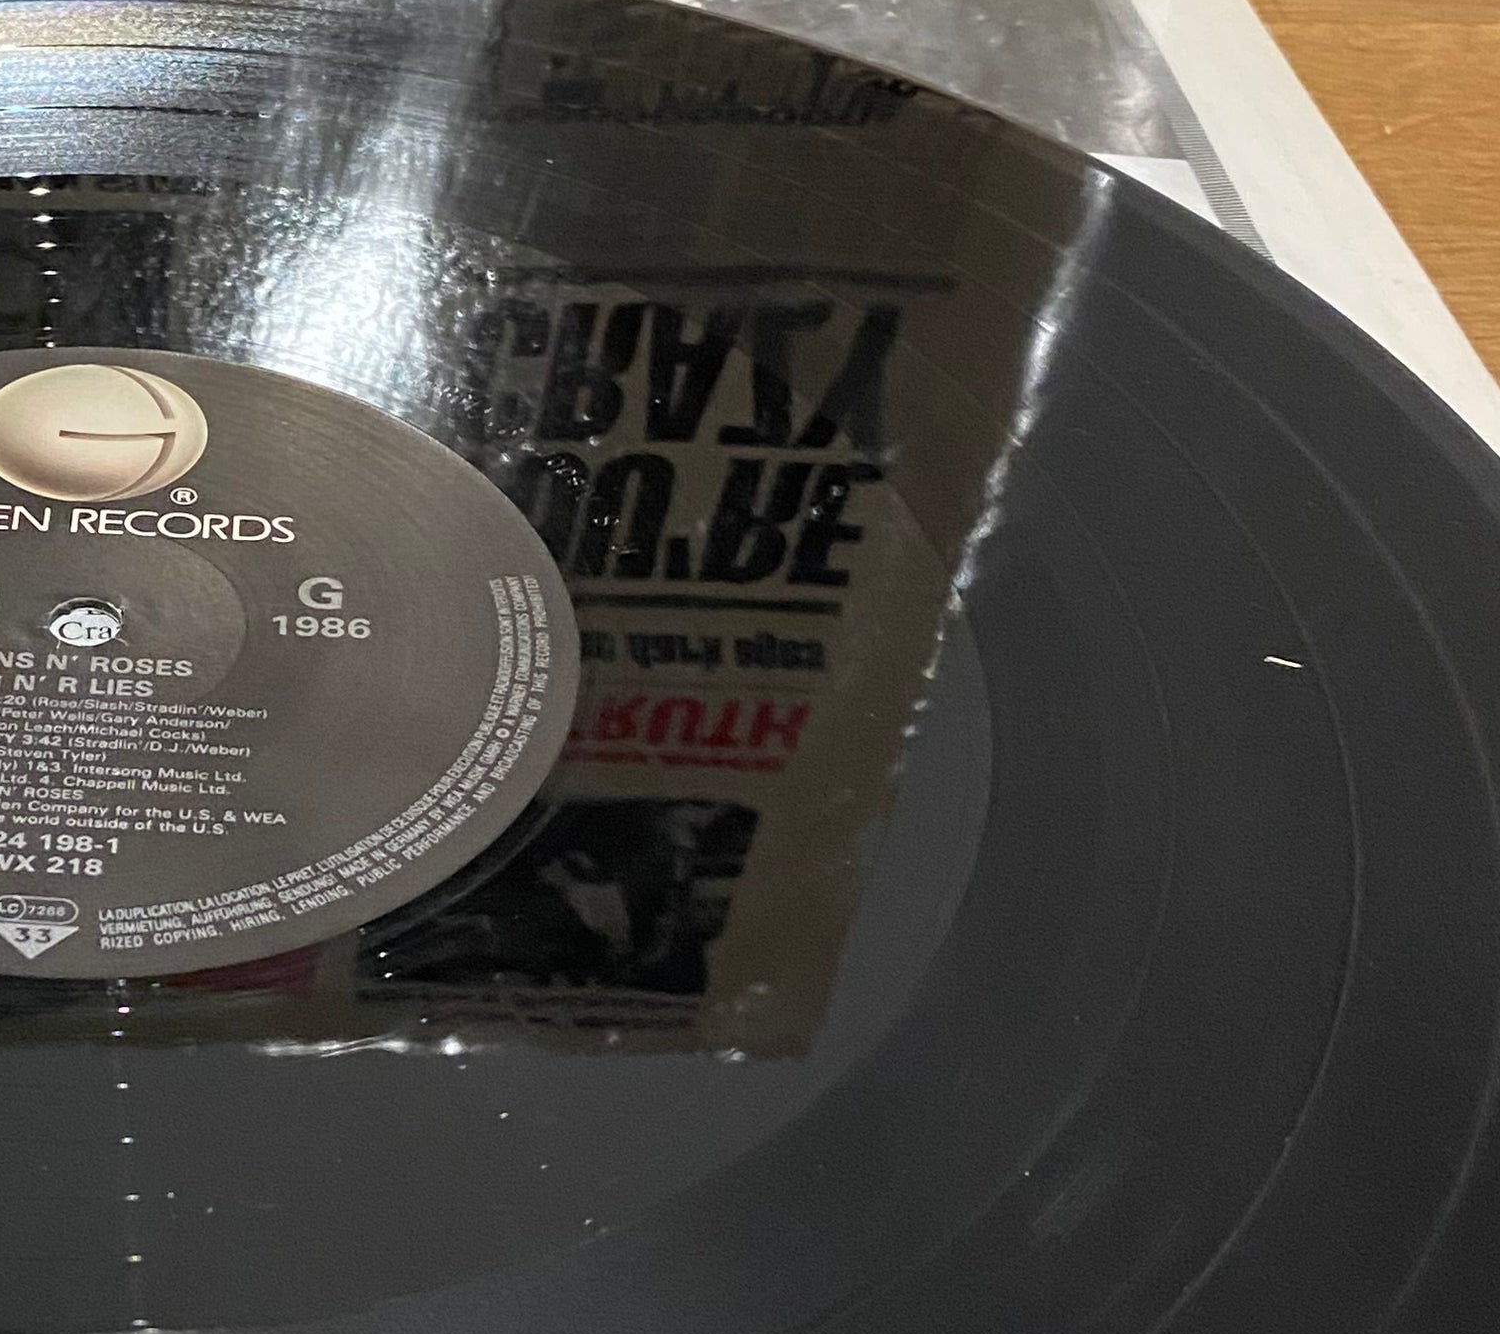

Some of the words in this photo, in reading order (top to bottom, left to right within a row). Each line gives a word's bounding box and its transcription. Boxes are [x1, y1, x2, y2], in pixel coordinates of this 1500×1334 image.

[69, 504, 295, 546] RECORDS
[297, 577, 343, 610] G
[272, 614, 372, 640] 1986
[91, 657, 194, 676] ROSES
[58, 677, 78, 694] R
[89, 678, 154, 697] LIES
[40, 834, 119, 853] 198-1
[47, 857, 103, 876] 218
[14, 927, 51, 943] 33
